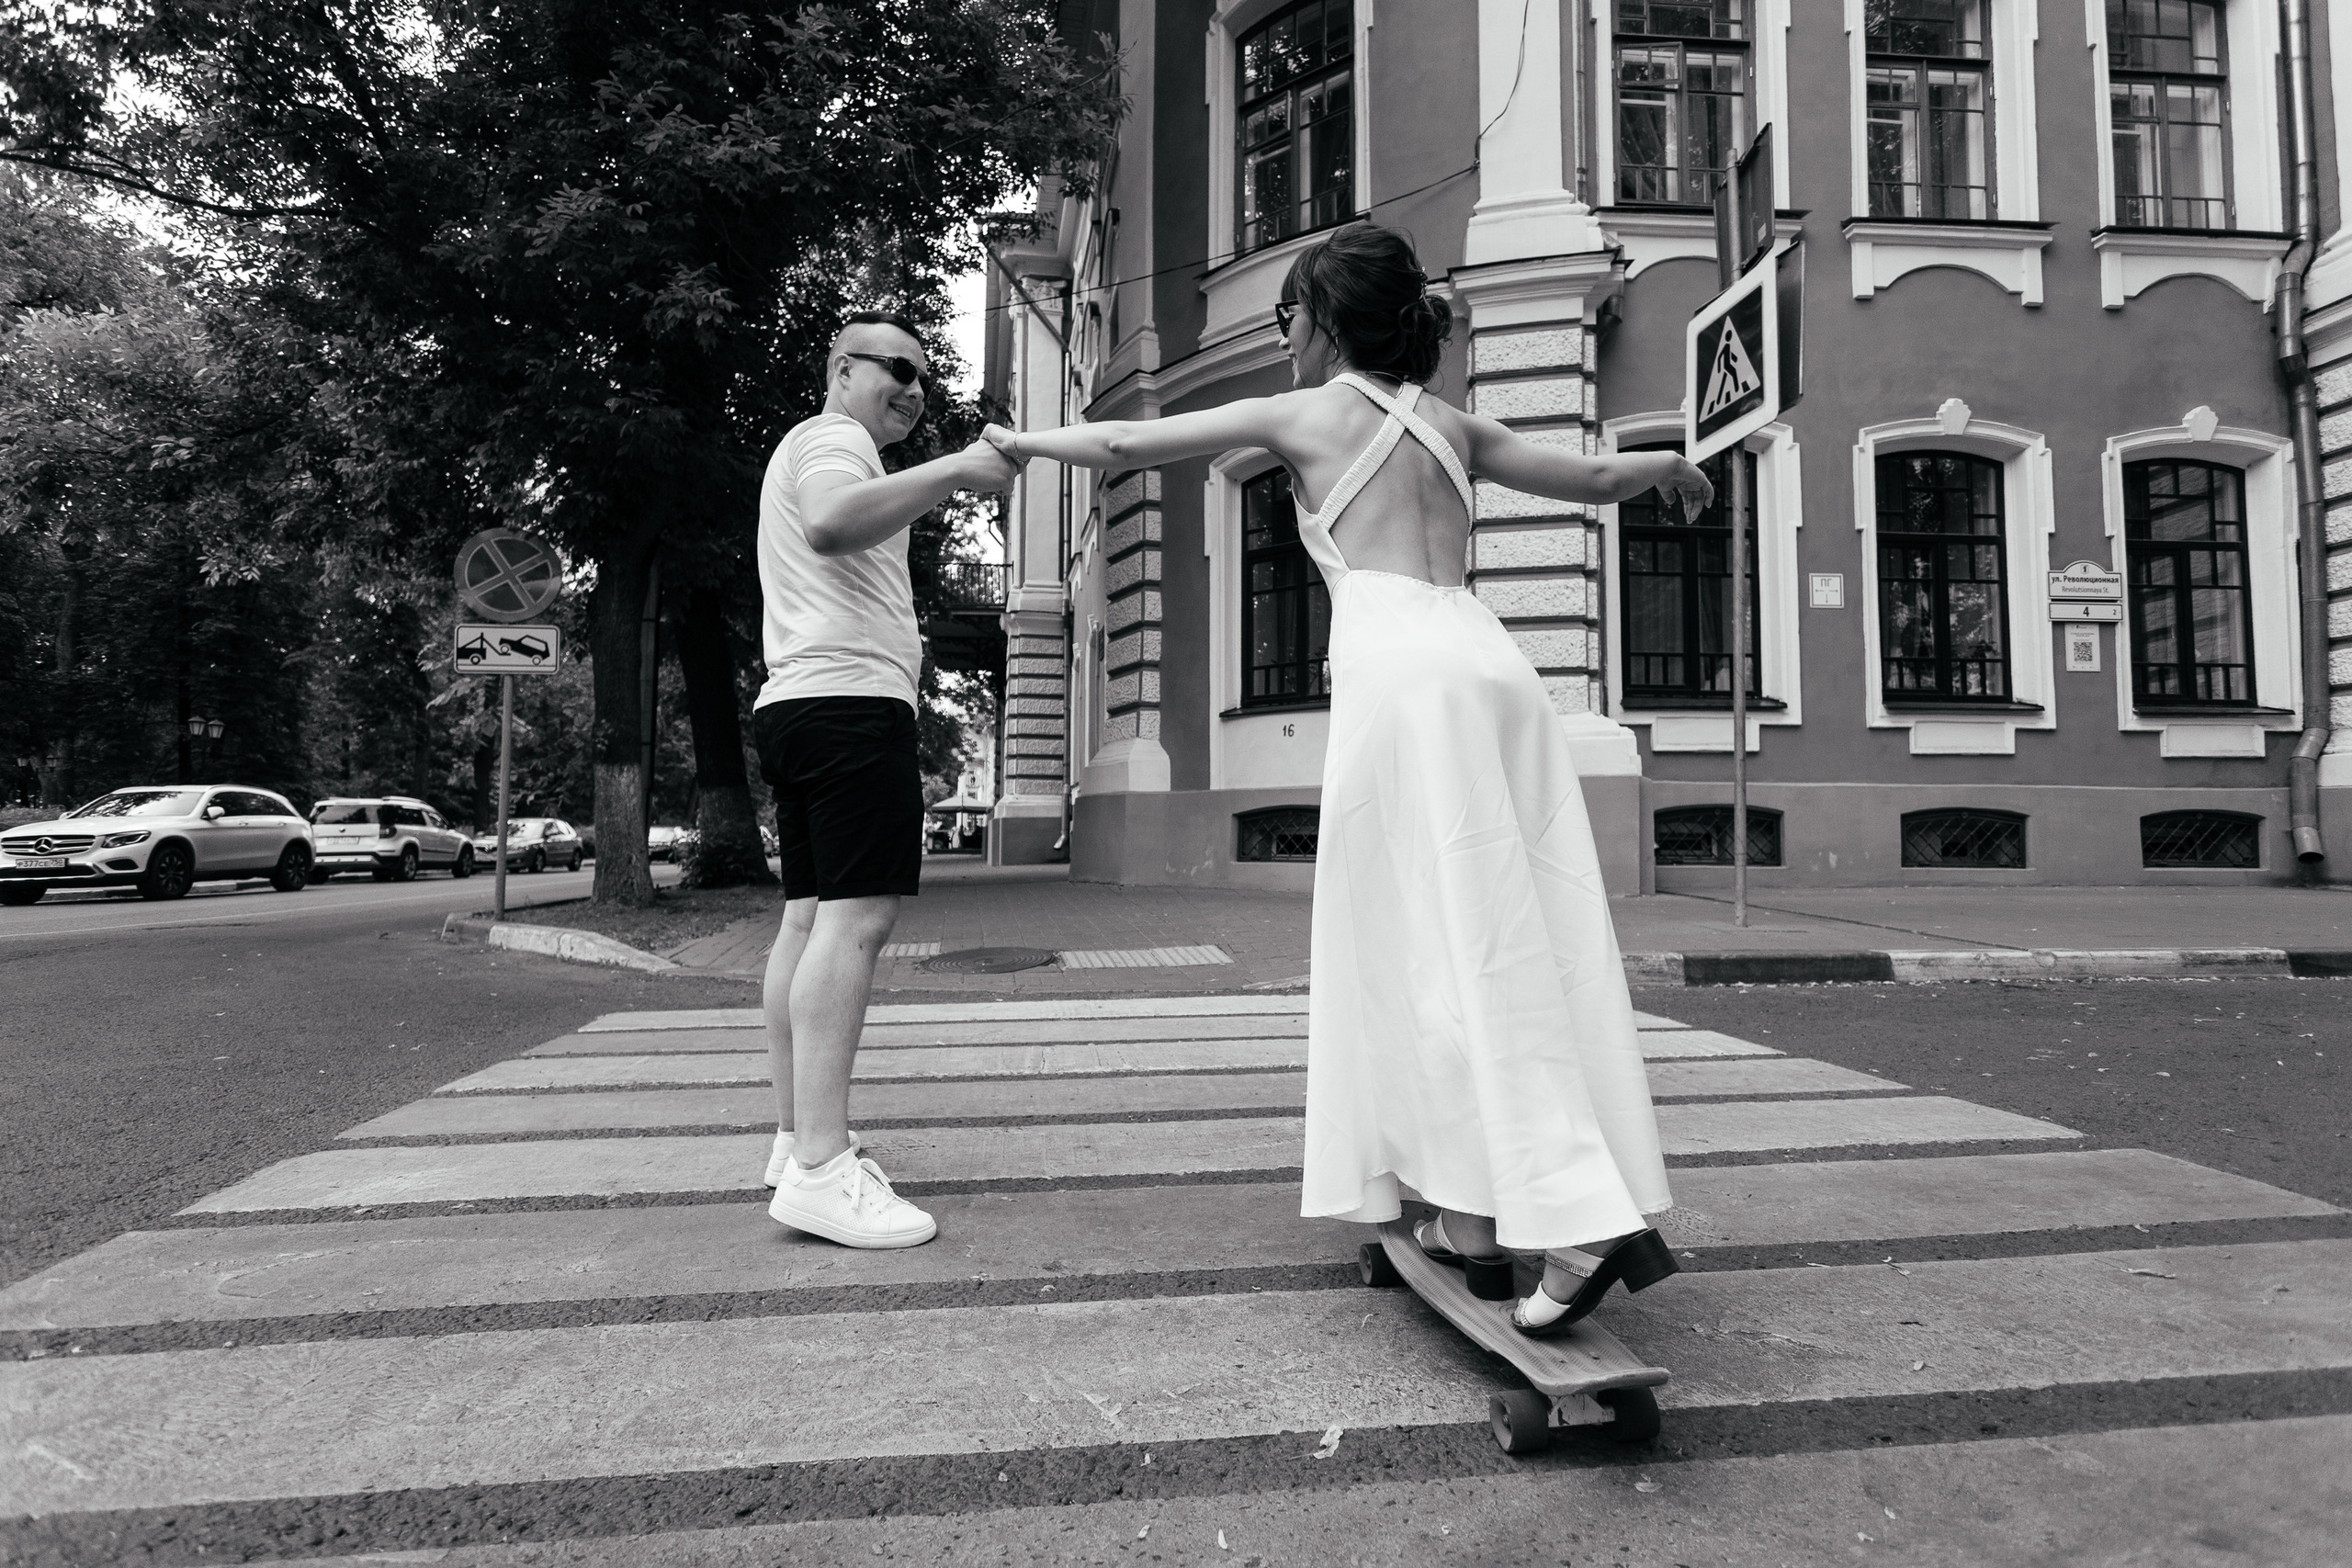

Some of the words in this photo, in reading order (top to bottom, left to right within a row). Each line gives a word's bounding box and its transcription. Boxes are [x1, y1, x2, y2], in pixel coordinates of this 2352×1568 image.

[1820, 578, 1832, 587] ПГ
[2051, 576, 2062, 584] ул.
[2064, 575, 2120, 583] Революционная
[2083, 606, 2090, 617] 4
[1283, 723, 1295, 738] 16
